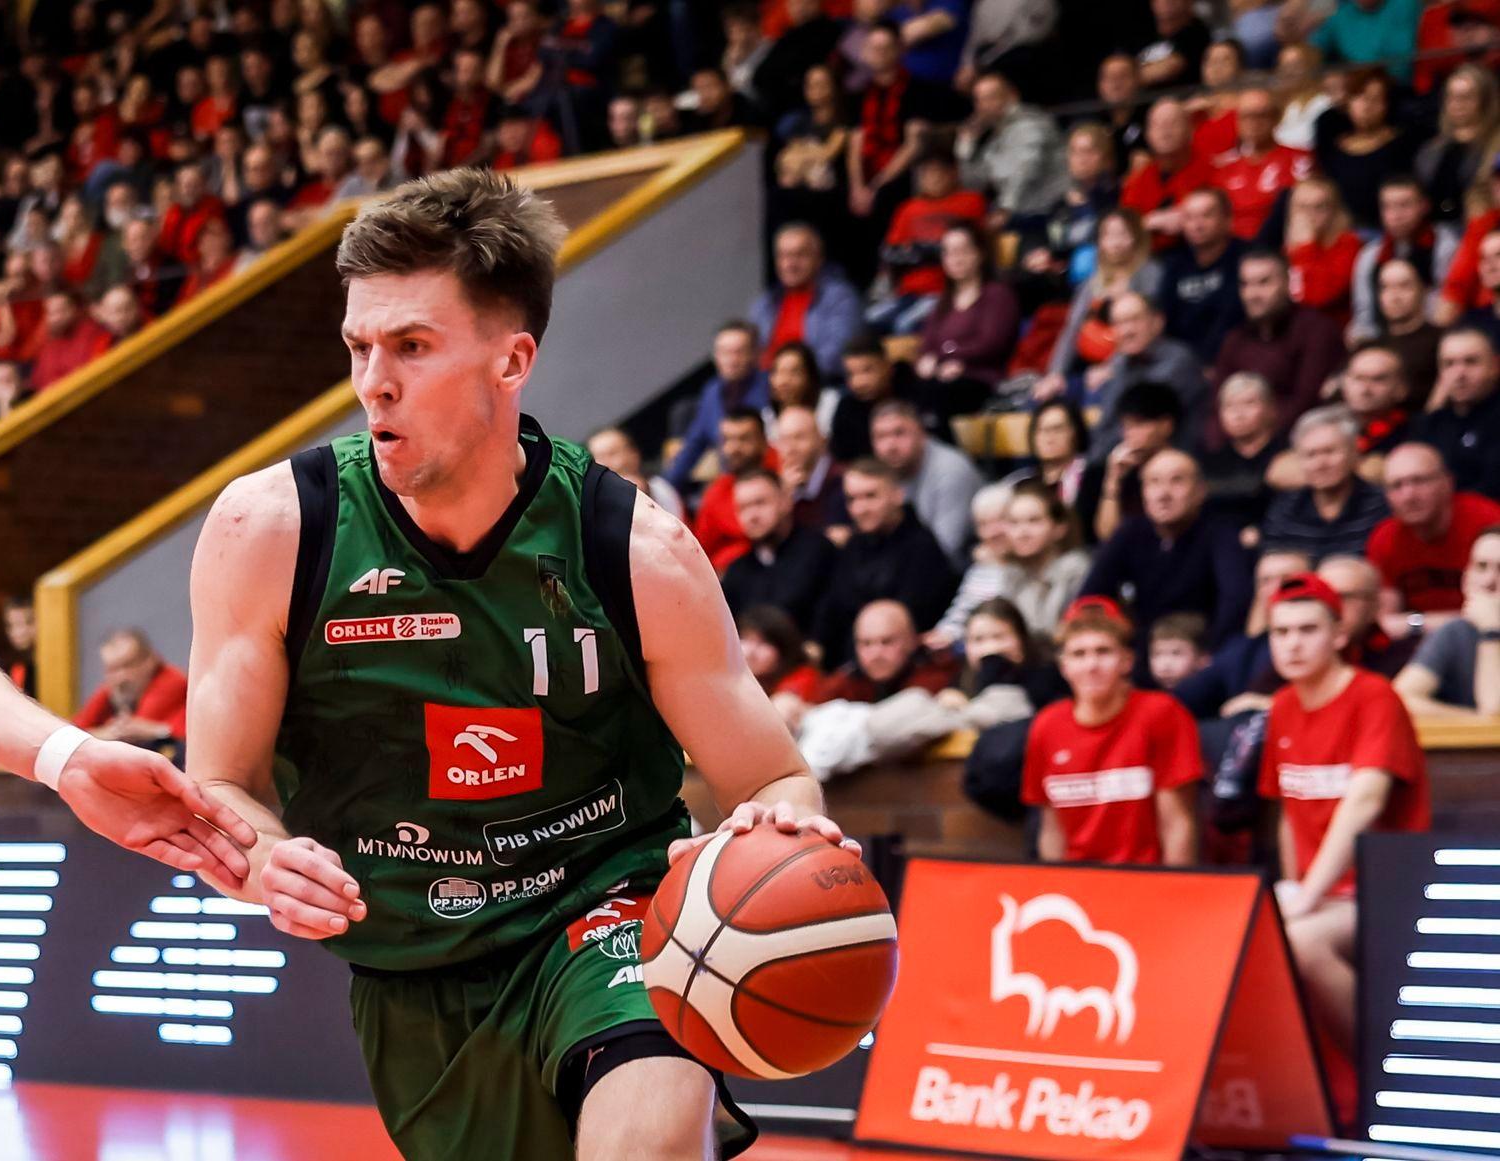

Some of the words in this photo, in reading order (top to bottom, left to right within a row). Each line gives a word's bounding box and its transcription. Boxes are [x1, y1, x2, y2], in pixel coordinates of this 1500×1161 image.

[331, 623, 388, 639] ORLEN
[420, 616, 454, 626] Basket
[421, 627, 442, 637] Liga
[523, 628, 599, 696] 11
[447, 764, 526, 786] ORLEN
[494, 833, 530, 852] PIB
[532, 794, 616, 841] NOWUM
[491, 880, 517, 898] PP
[522, 867, 565, 892] DOM
[433, 898, 450, 908] PP
[453, 897, 482, 907] DOM
[910, 1066, 1020, 1130] Bank
[1018, 1077, 1152, 1140] Pekao
